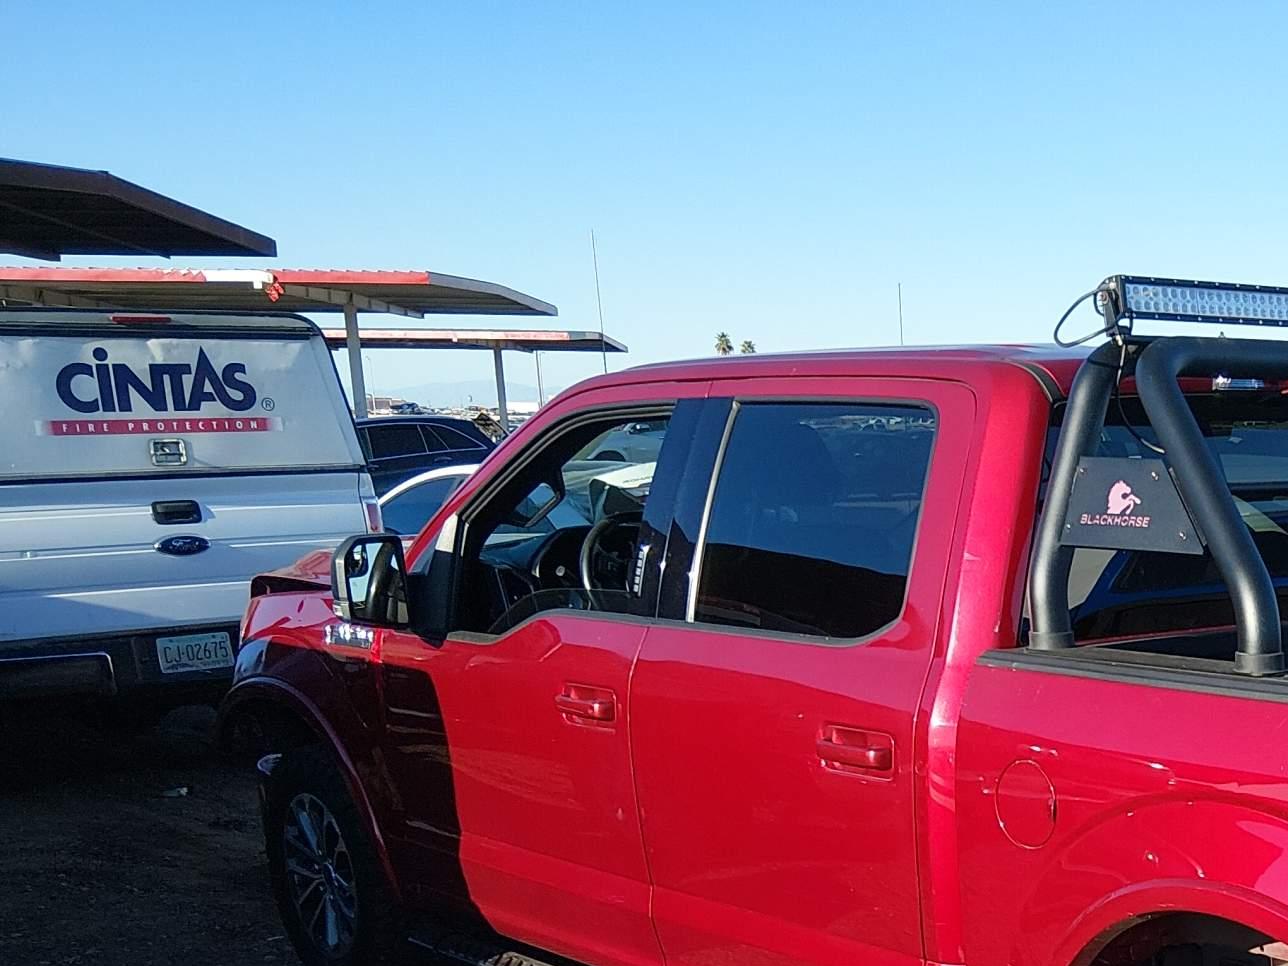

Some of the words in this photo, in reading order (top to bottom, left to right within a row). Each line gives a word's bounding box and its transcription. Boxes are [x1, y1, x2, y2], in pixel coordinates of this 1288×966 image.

[62, 423, 109, 433] FIRE
[128, 420, 258, 432] PROTECTION
[1080, 513, 1150, 528] BLACKHORSE
